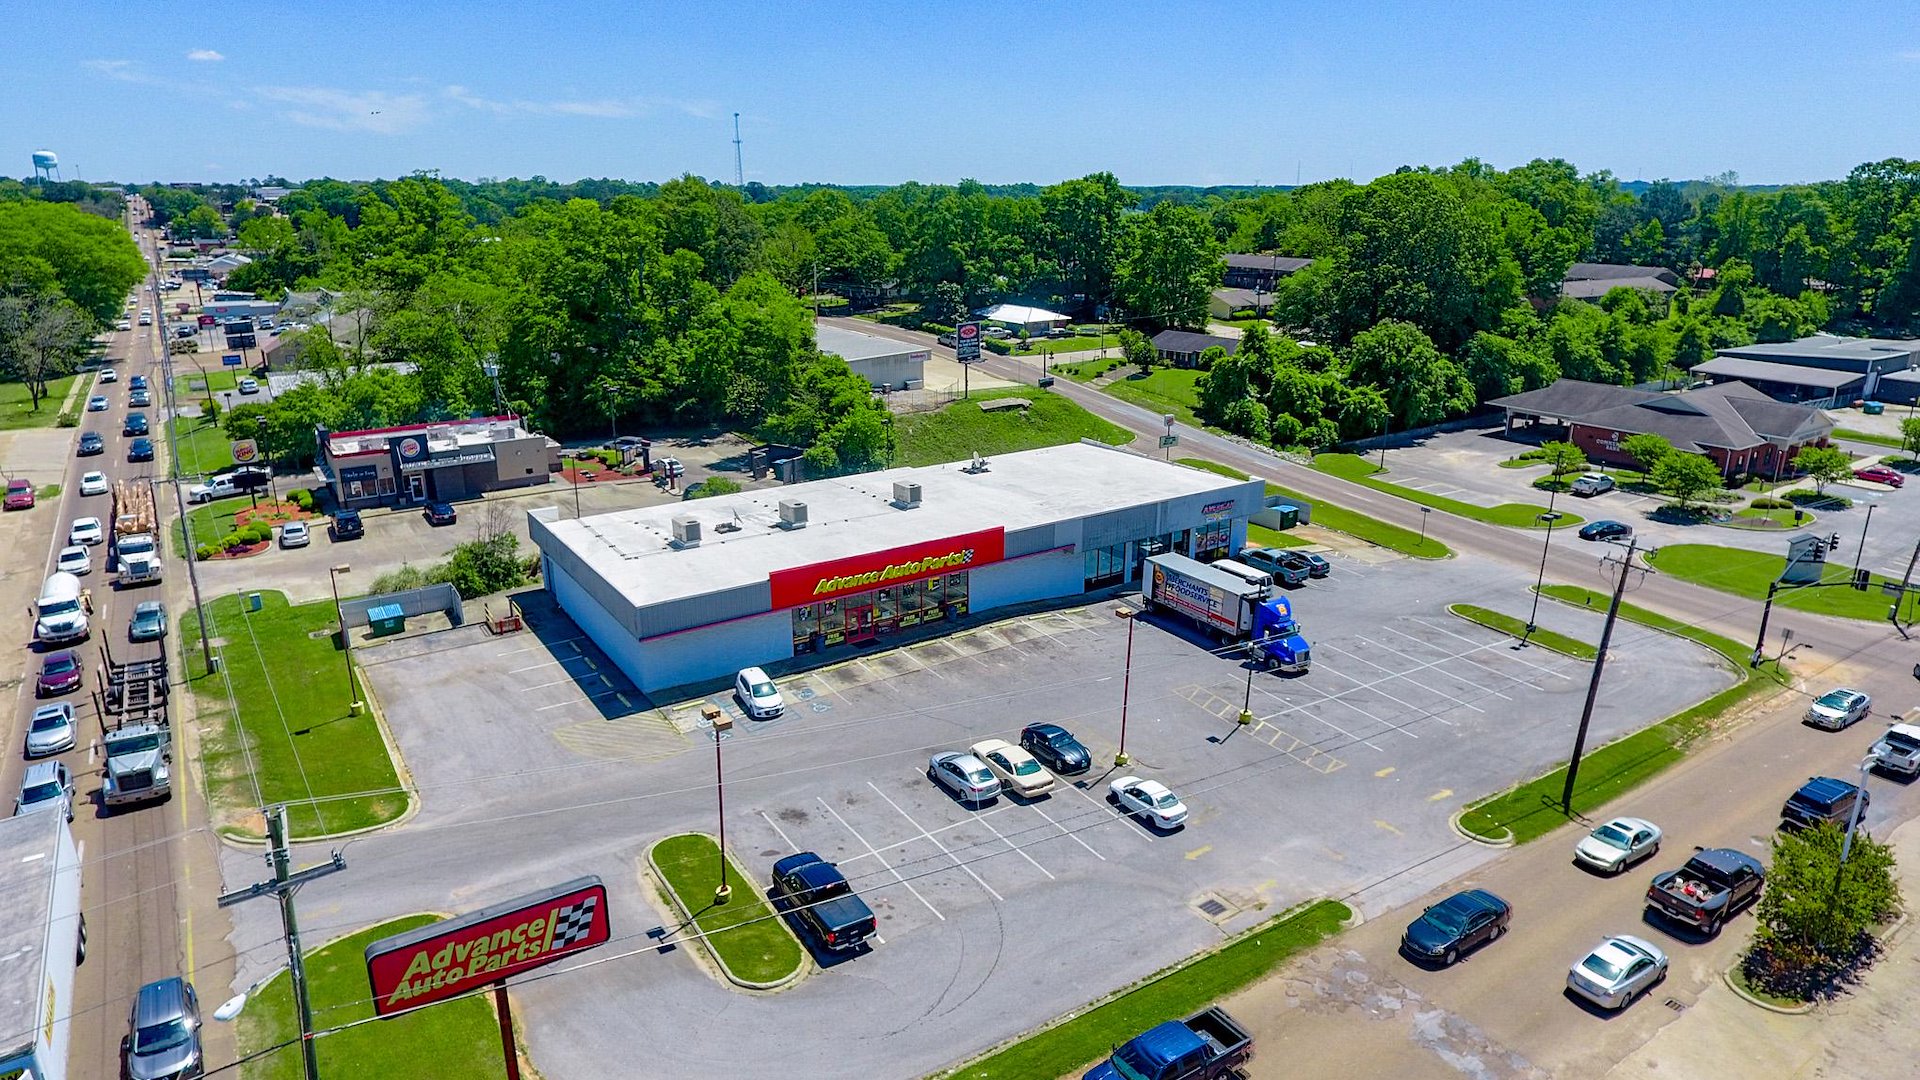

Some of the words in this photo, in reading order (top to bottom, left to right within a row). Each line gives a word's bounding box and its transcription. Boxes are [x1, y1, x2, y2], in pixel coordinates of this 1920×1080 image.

[813, 571, 878, 595] Advance
[880, 561, 919, 581] Auto
[920, 553, 961, 572] Parts
[1167, 573, 1209, 597] MERCHANTS
[1171, 583, 1218, 608] FOODSERVICE
[403, 918, 546, 980] Advance
[387, 966, 464, 1005] Auto
[467, 939, 541, 977] Parts
